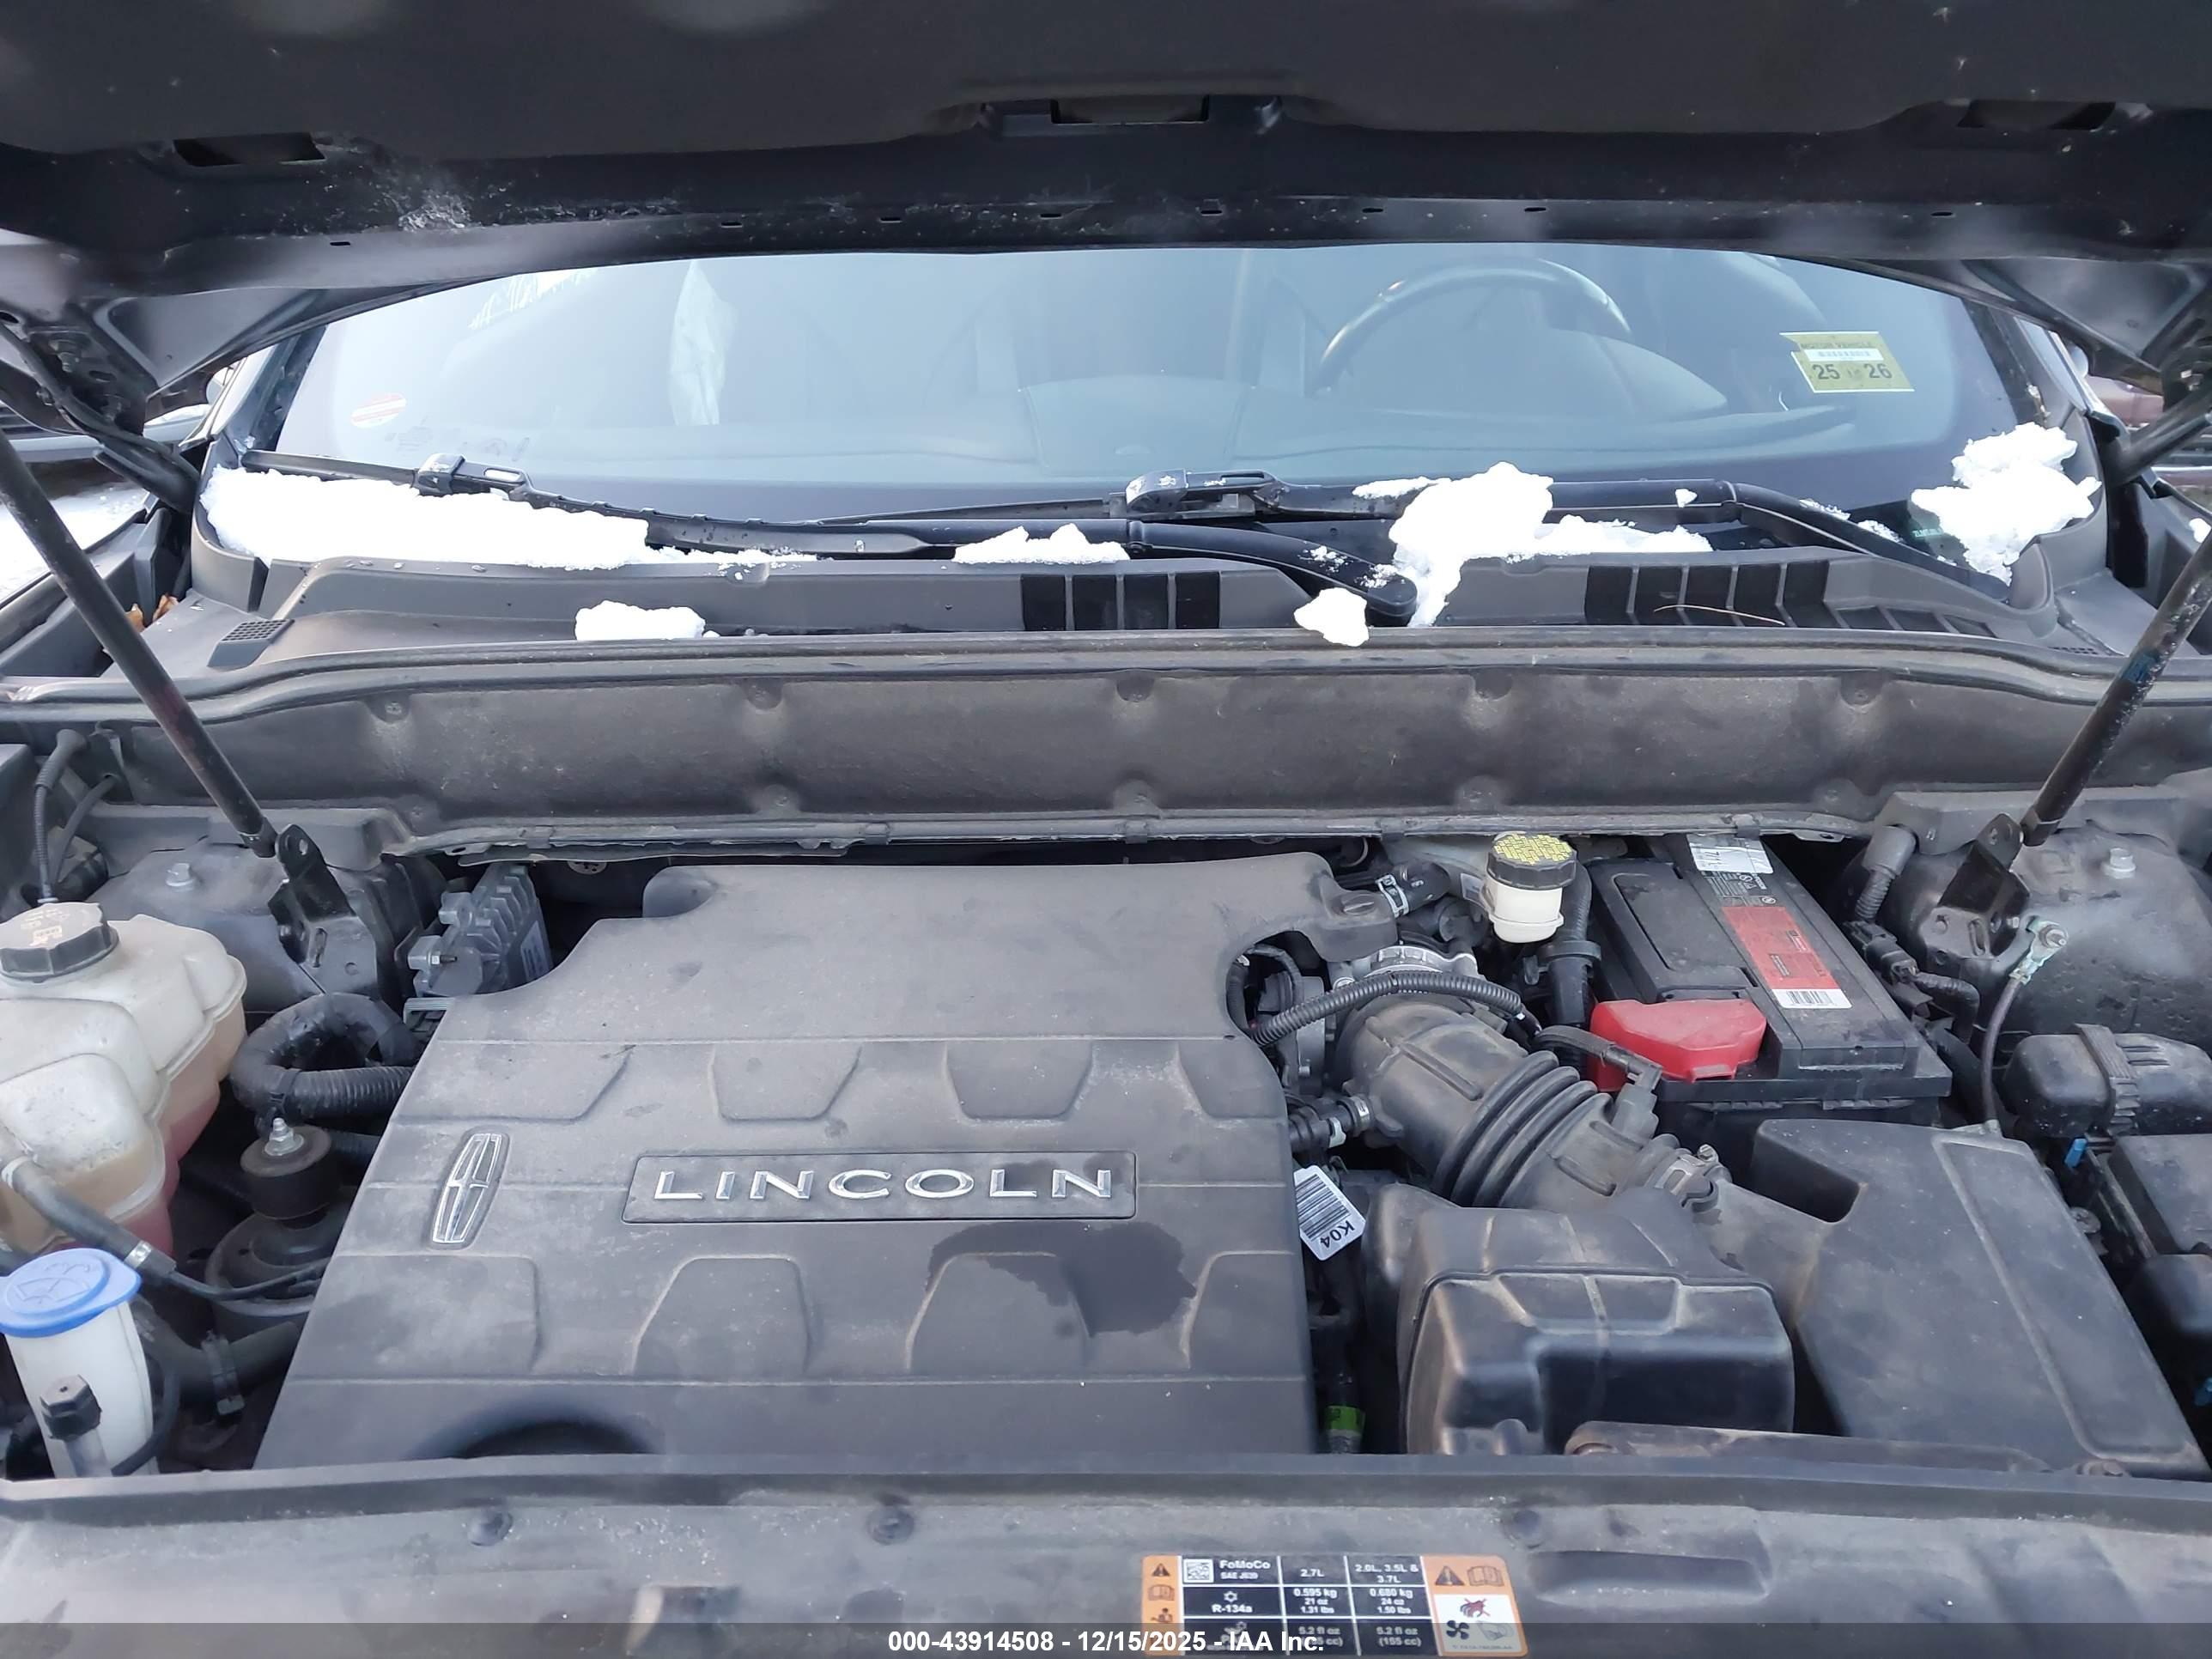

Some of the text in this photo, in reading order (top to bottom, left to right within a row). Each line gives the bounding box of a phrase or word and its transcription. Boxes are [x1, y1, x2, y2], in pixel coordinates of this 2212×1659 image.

[1812, 364, 1840, 380] 25
[1863, 363, 1893, 379] 26
[654, 1169, 1112, 1200] LINCOLN
[1320, 1219, 1355, 1249] K04
[1219, 1559, 1271, 1570] FoMoCo
[1300, 1568, 1325, 1577] 2.7L
[1376, 1575, 1401, 1583] 3.7L
[1323, 1588, 1338, 1599] kg
[1399, 1588, 1413, 1599] kg
[1212, 1603, 1253, 1613] R-134a
[1300, 1606, 1335, 1614] 1.31 lbs
[1397, 1606, 1412, 1614] lbs
[1298, 1626, 1340, 1635] 5.2 fl oz
[1376, 1626, 1419, 1635] 5.2 fl oz
[1325, 1637, 1344, 1647] cc)
[1378, 1637, 1422, 1647] (155 cc)
